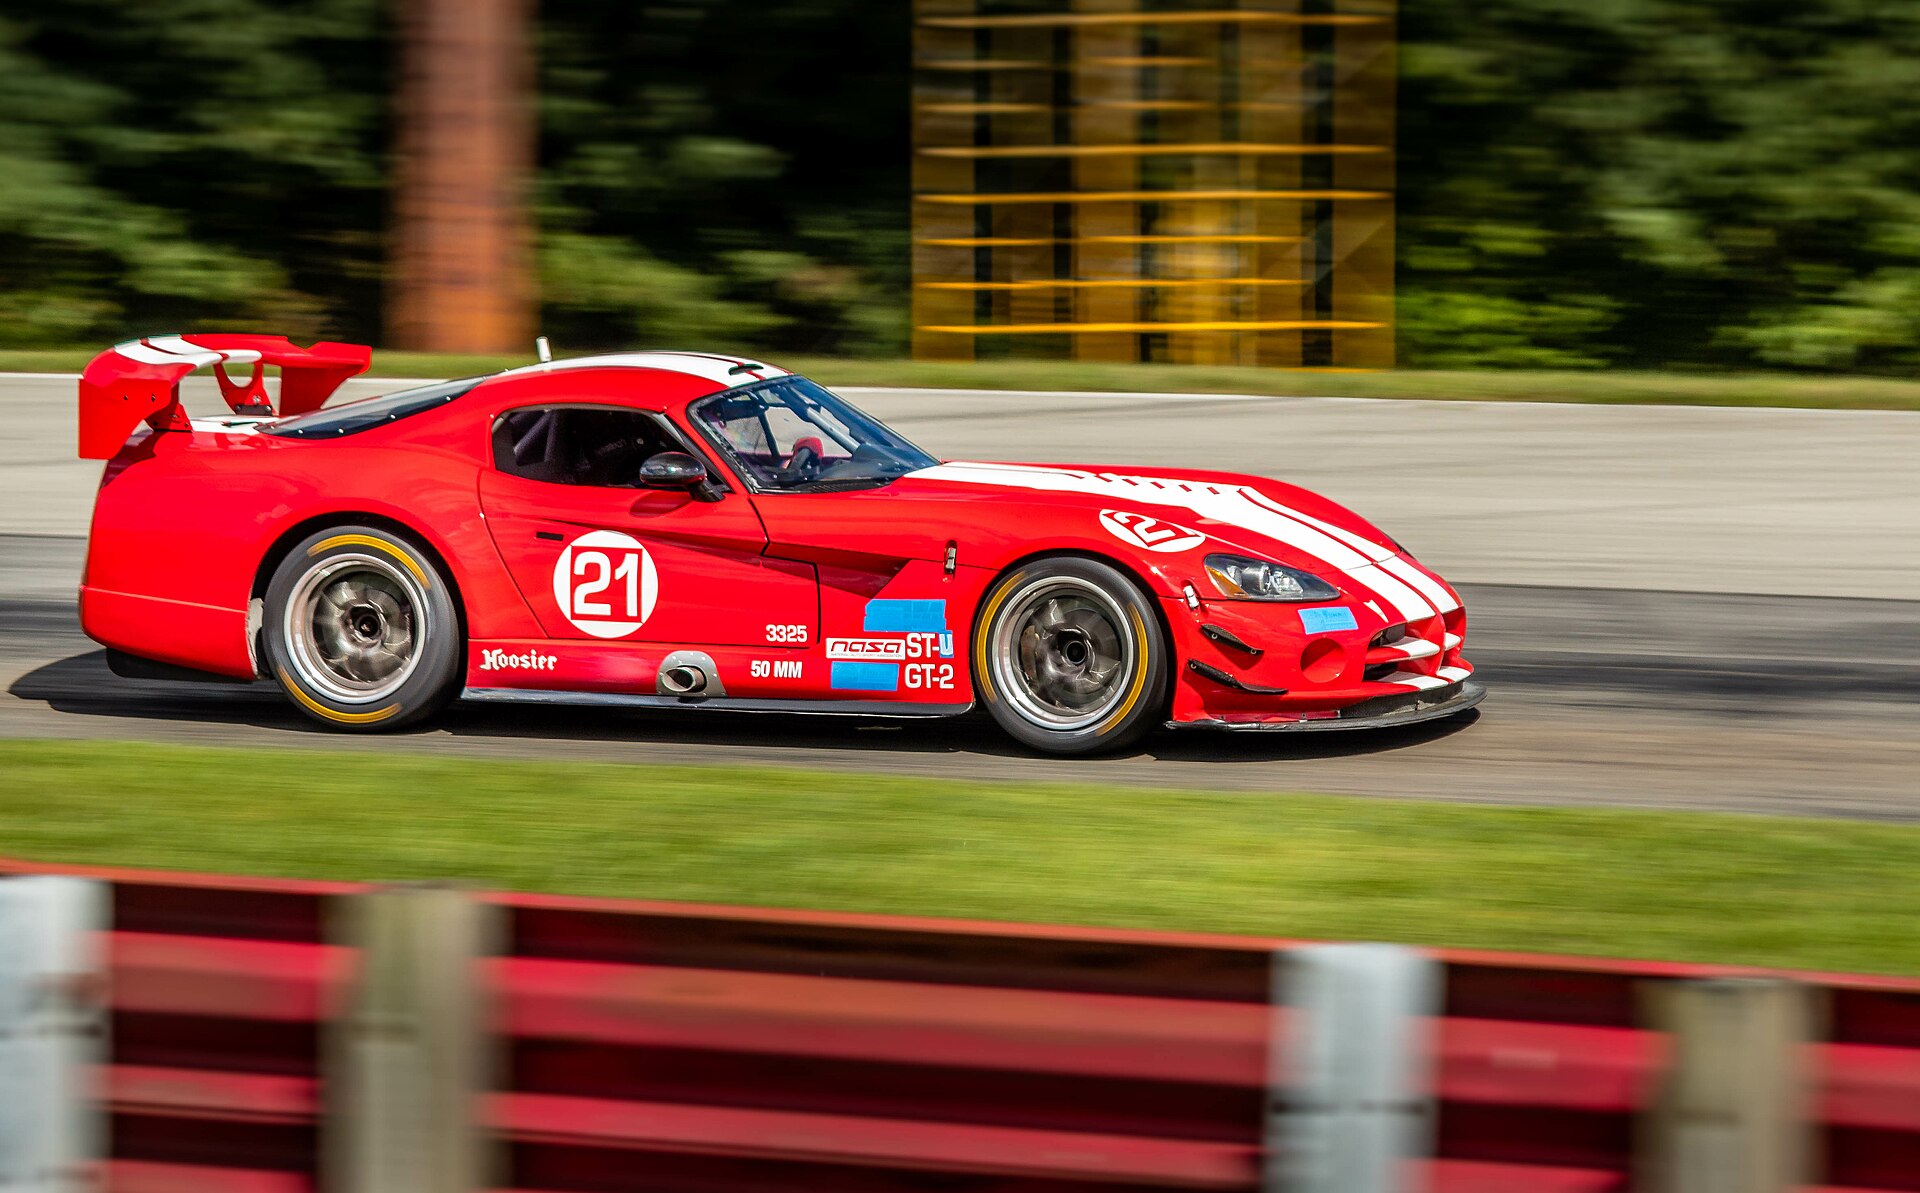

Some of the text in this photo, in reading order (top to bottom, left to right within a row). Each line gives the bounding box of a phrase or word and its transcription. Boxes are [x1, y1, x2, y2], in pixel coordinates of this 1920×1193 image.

[1113, 511, 1196, 543] 2
[573, 551, 639, 617] 21
[765, 623, 808, 643] 3325
[906, 632, 954, 658] ST-U
[479, 648, 558, 671] Hoosier
[750, 659, 803, 679] 50 MM
[904, 663, 955, 689] GT-2
